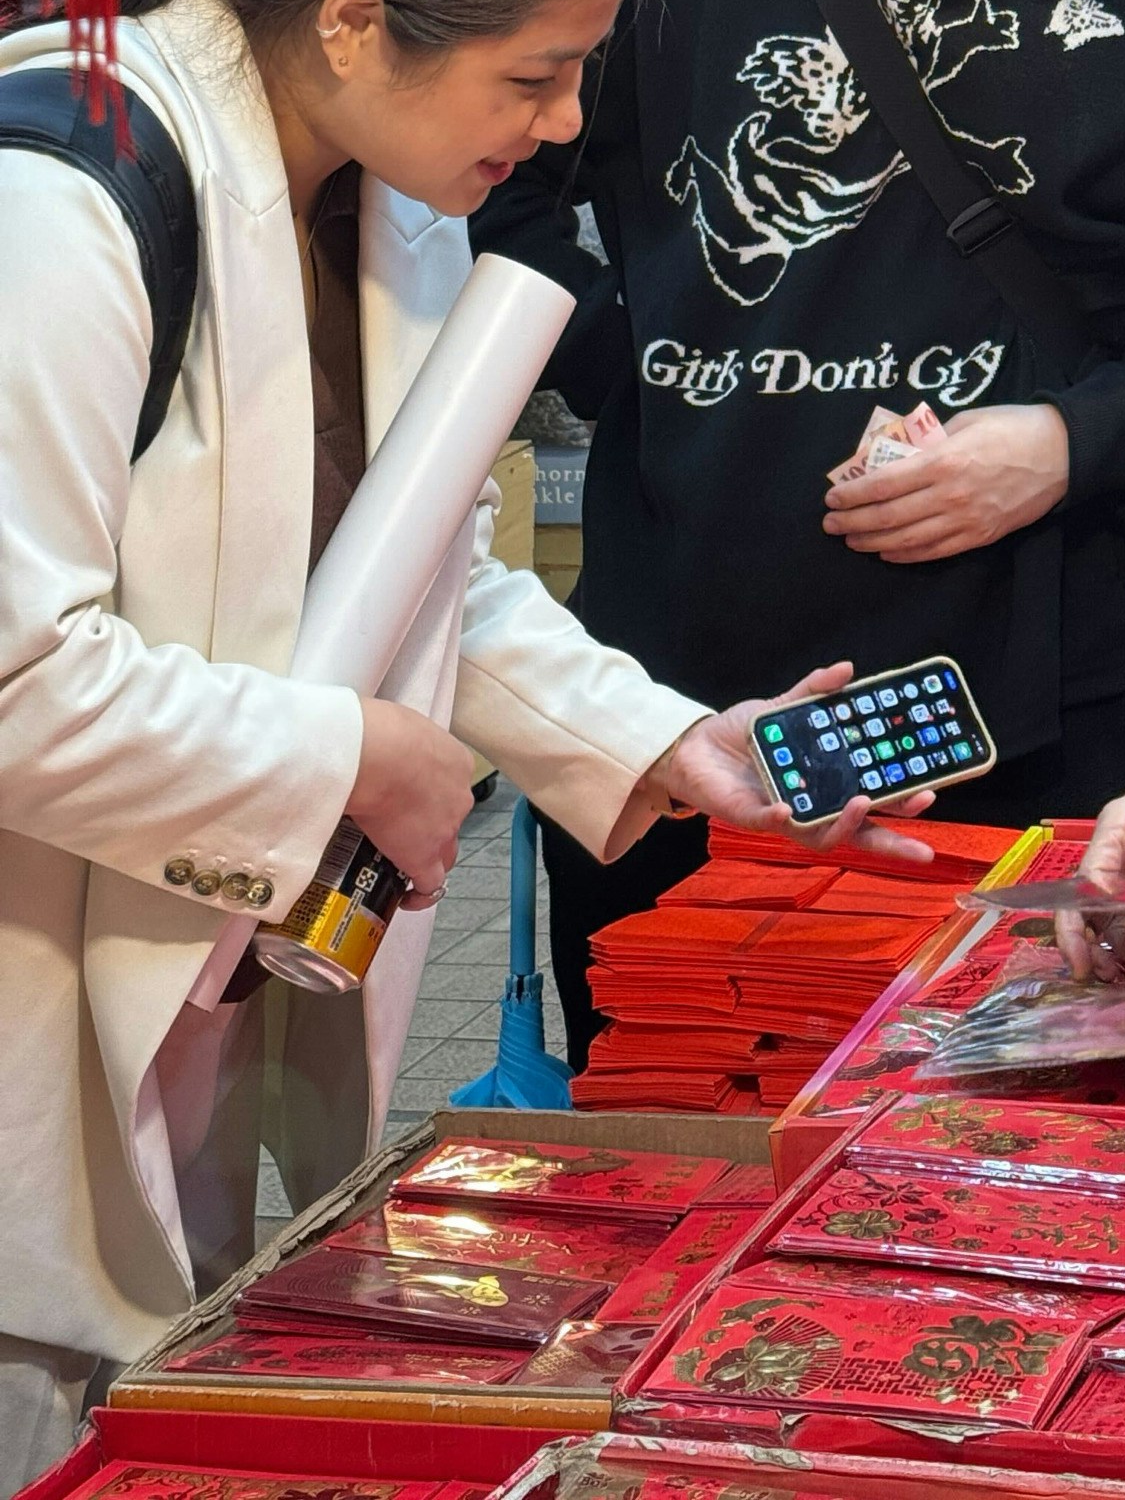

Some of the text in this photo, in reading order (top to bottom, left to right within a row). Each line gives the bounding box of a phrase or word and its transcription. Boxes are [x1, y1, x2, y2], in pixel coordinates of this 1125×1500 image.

[641, 338, 1005, 407] Girls Don't Cry
